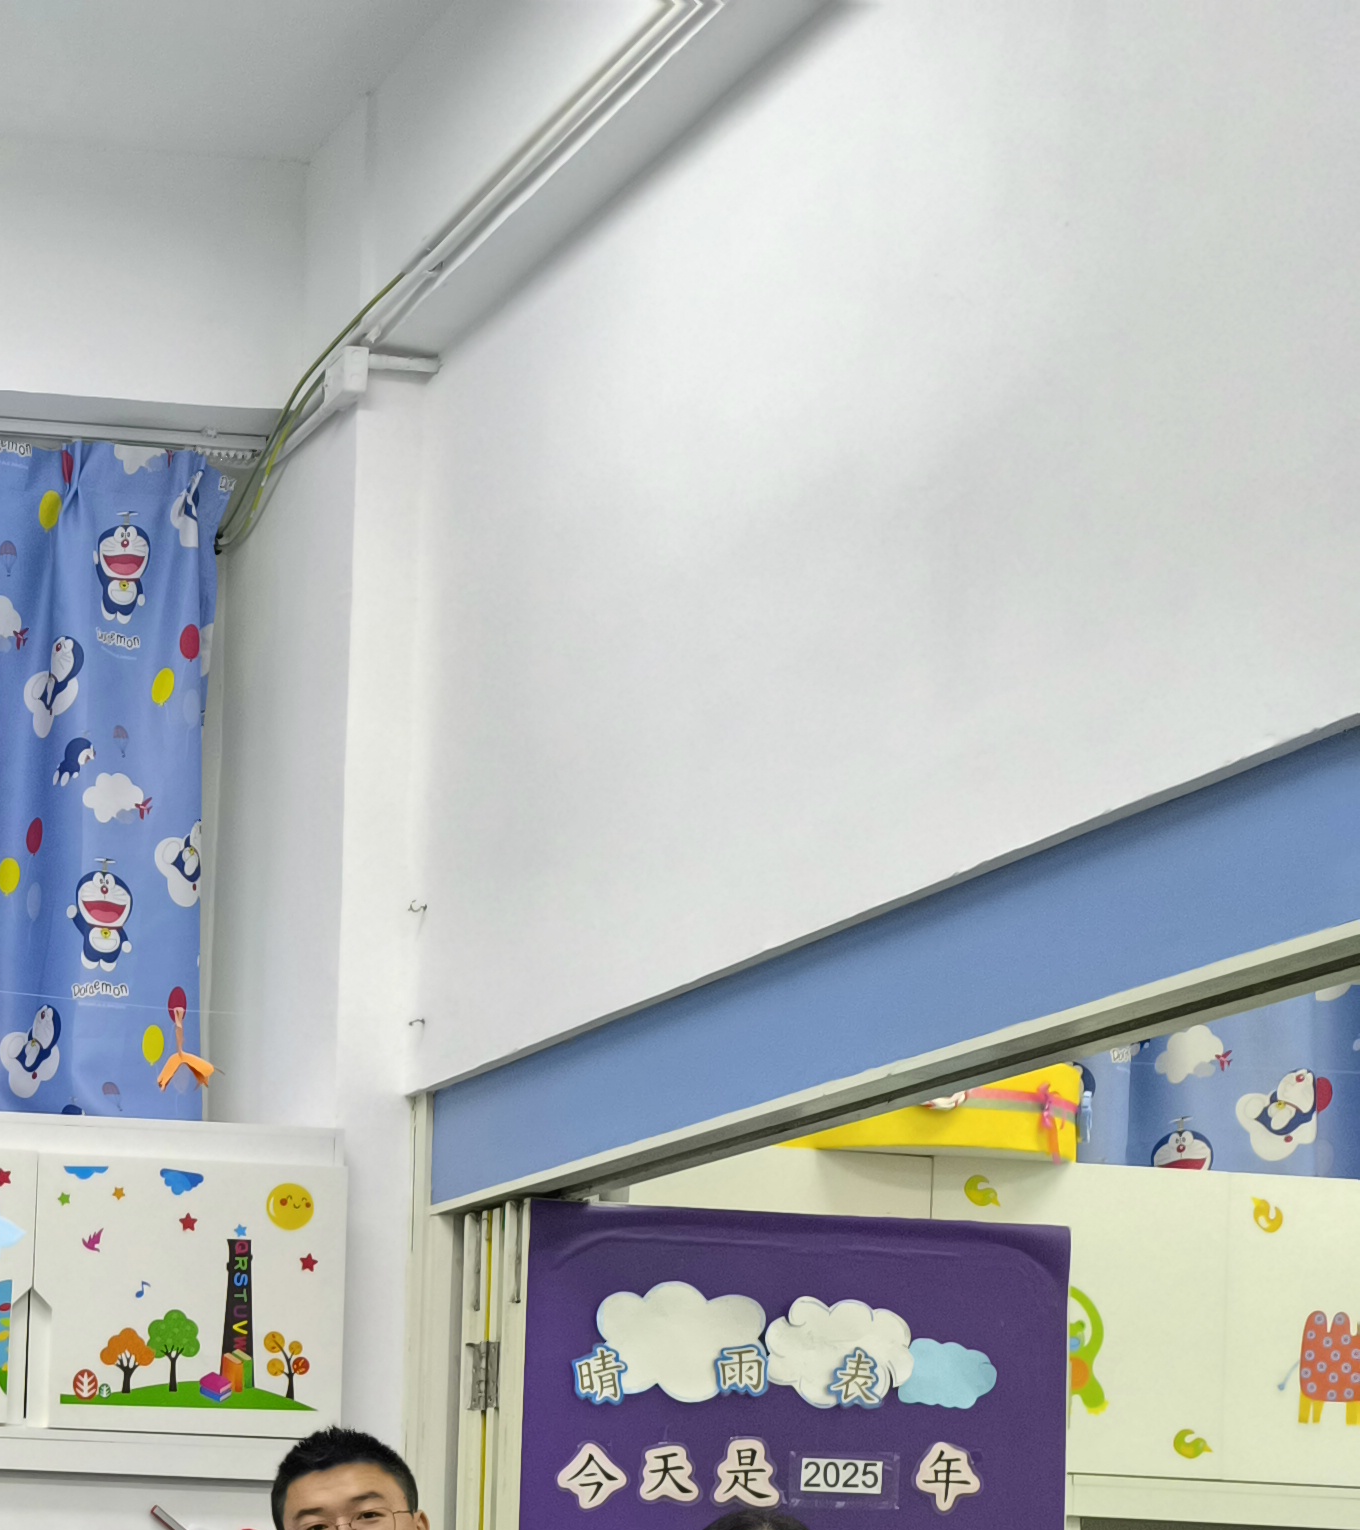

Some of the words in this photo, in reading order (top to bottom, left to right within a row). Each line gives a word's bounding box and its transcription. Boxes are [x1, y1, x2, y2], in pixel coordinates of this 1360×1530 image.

[71, 980, 129, 998] Doraemon
[567, 1447, 773, 1503] 今天是
[803, 1461, 880, 1489] 2025
[922, 1449, 972, 1503] 年
